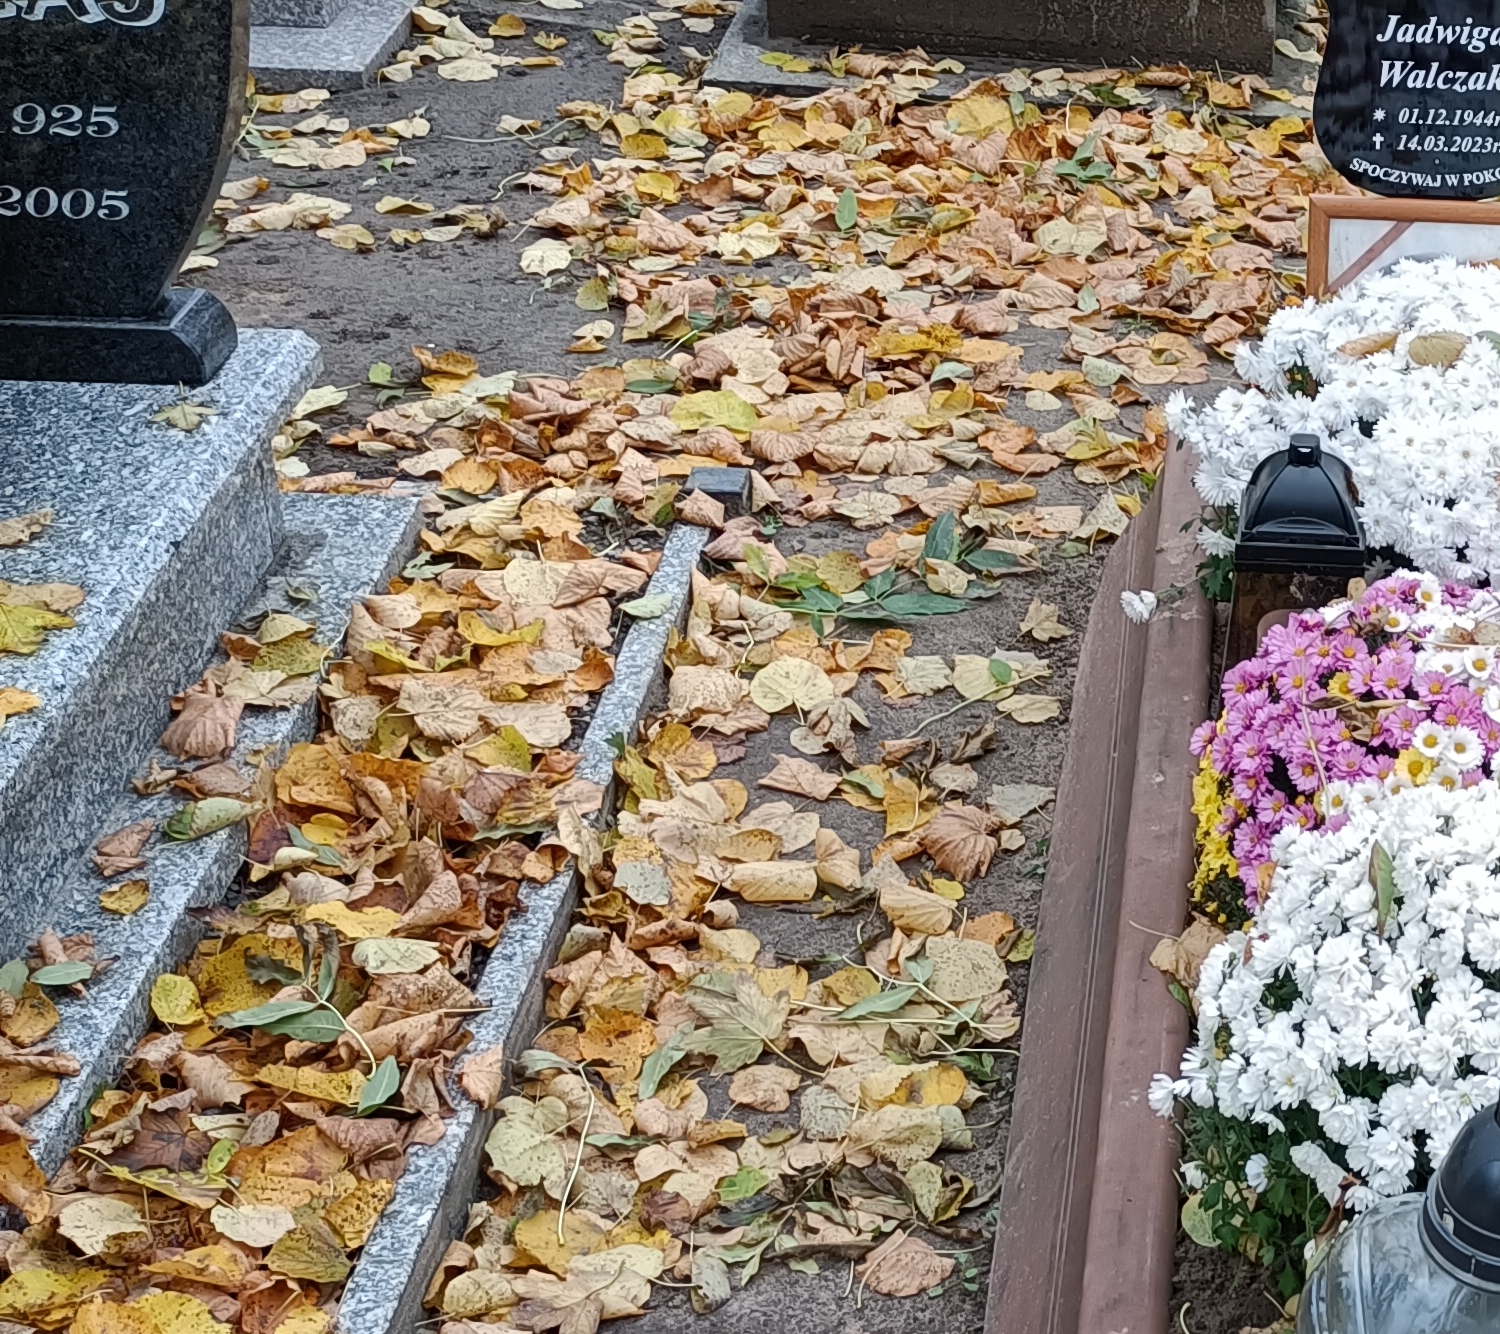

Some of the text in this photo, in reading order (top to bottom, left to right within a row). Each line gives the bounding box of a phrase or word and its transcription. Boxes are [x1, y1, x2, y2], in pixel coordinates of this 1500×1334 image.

[0, 102, 120, 138] 925
[1349, 157, 1443, 187] SPOCZYWAJ
[1445, 174, 1460, 186] W
[0, 184, 130, 221] 2005
